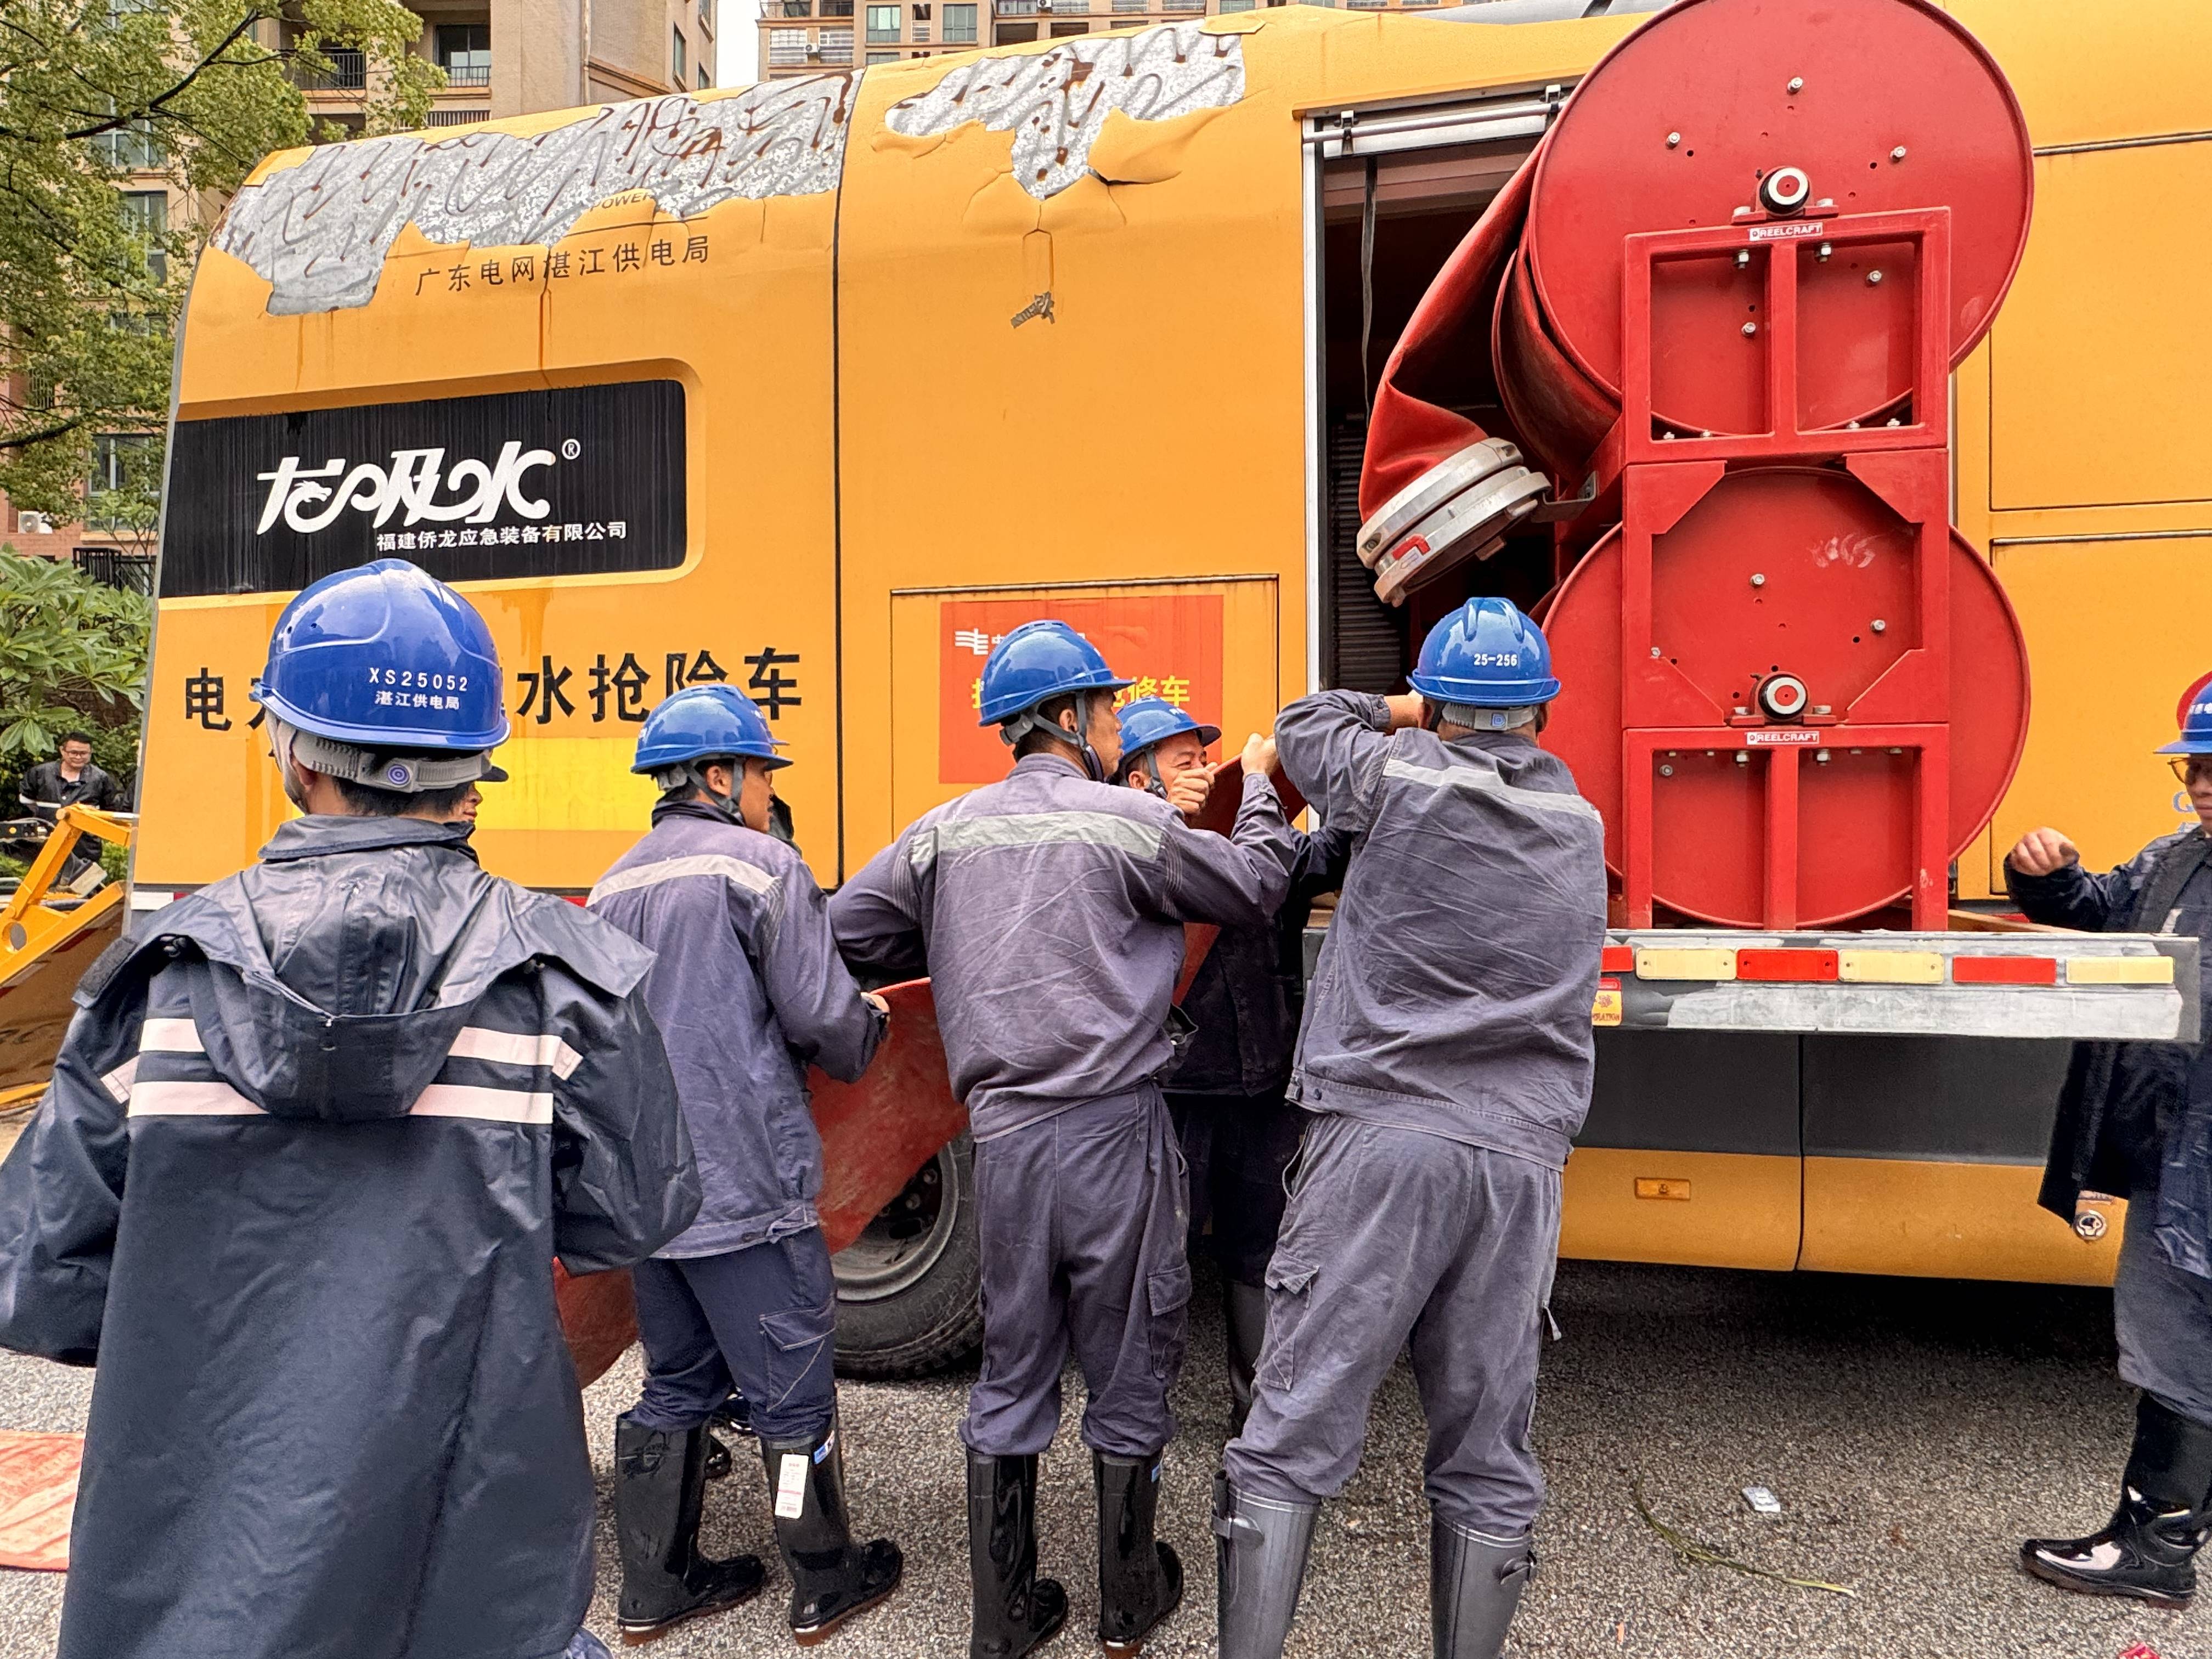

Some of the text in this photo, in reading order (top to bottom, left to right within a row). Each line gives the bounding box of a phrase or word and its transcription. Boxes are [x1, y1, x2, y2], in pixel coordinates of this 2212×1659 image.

[1759, 225, 1820, 238] REELCRAFT
[415, 235, 709, 296] 广东电网湛江供电局
[376, 521, 627, 551] 福建侨龙应急装备有限公司
[1474, 653, 1517, 667] 25-256
[369, 667, 467, 692] XS25052
[374, 690, 460, 710] 湛江供电局
[1757, 733, 1817, 742] REELCRAFT
